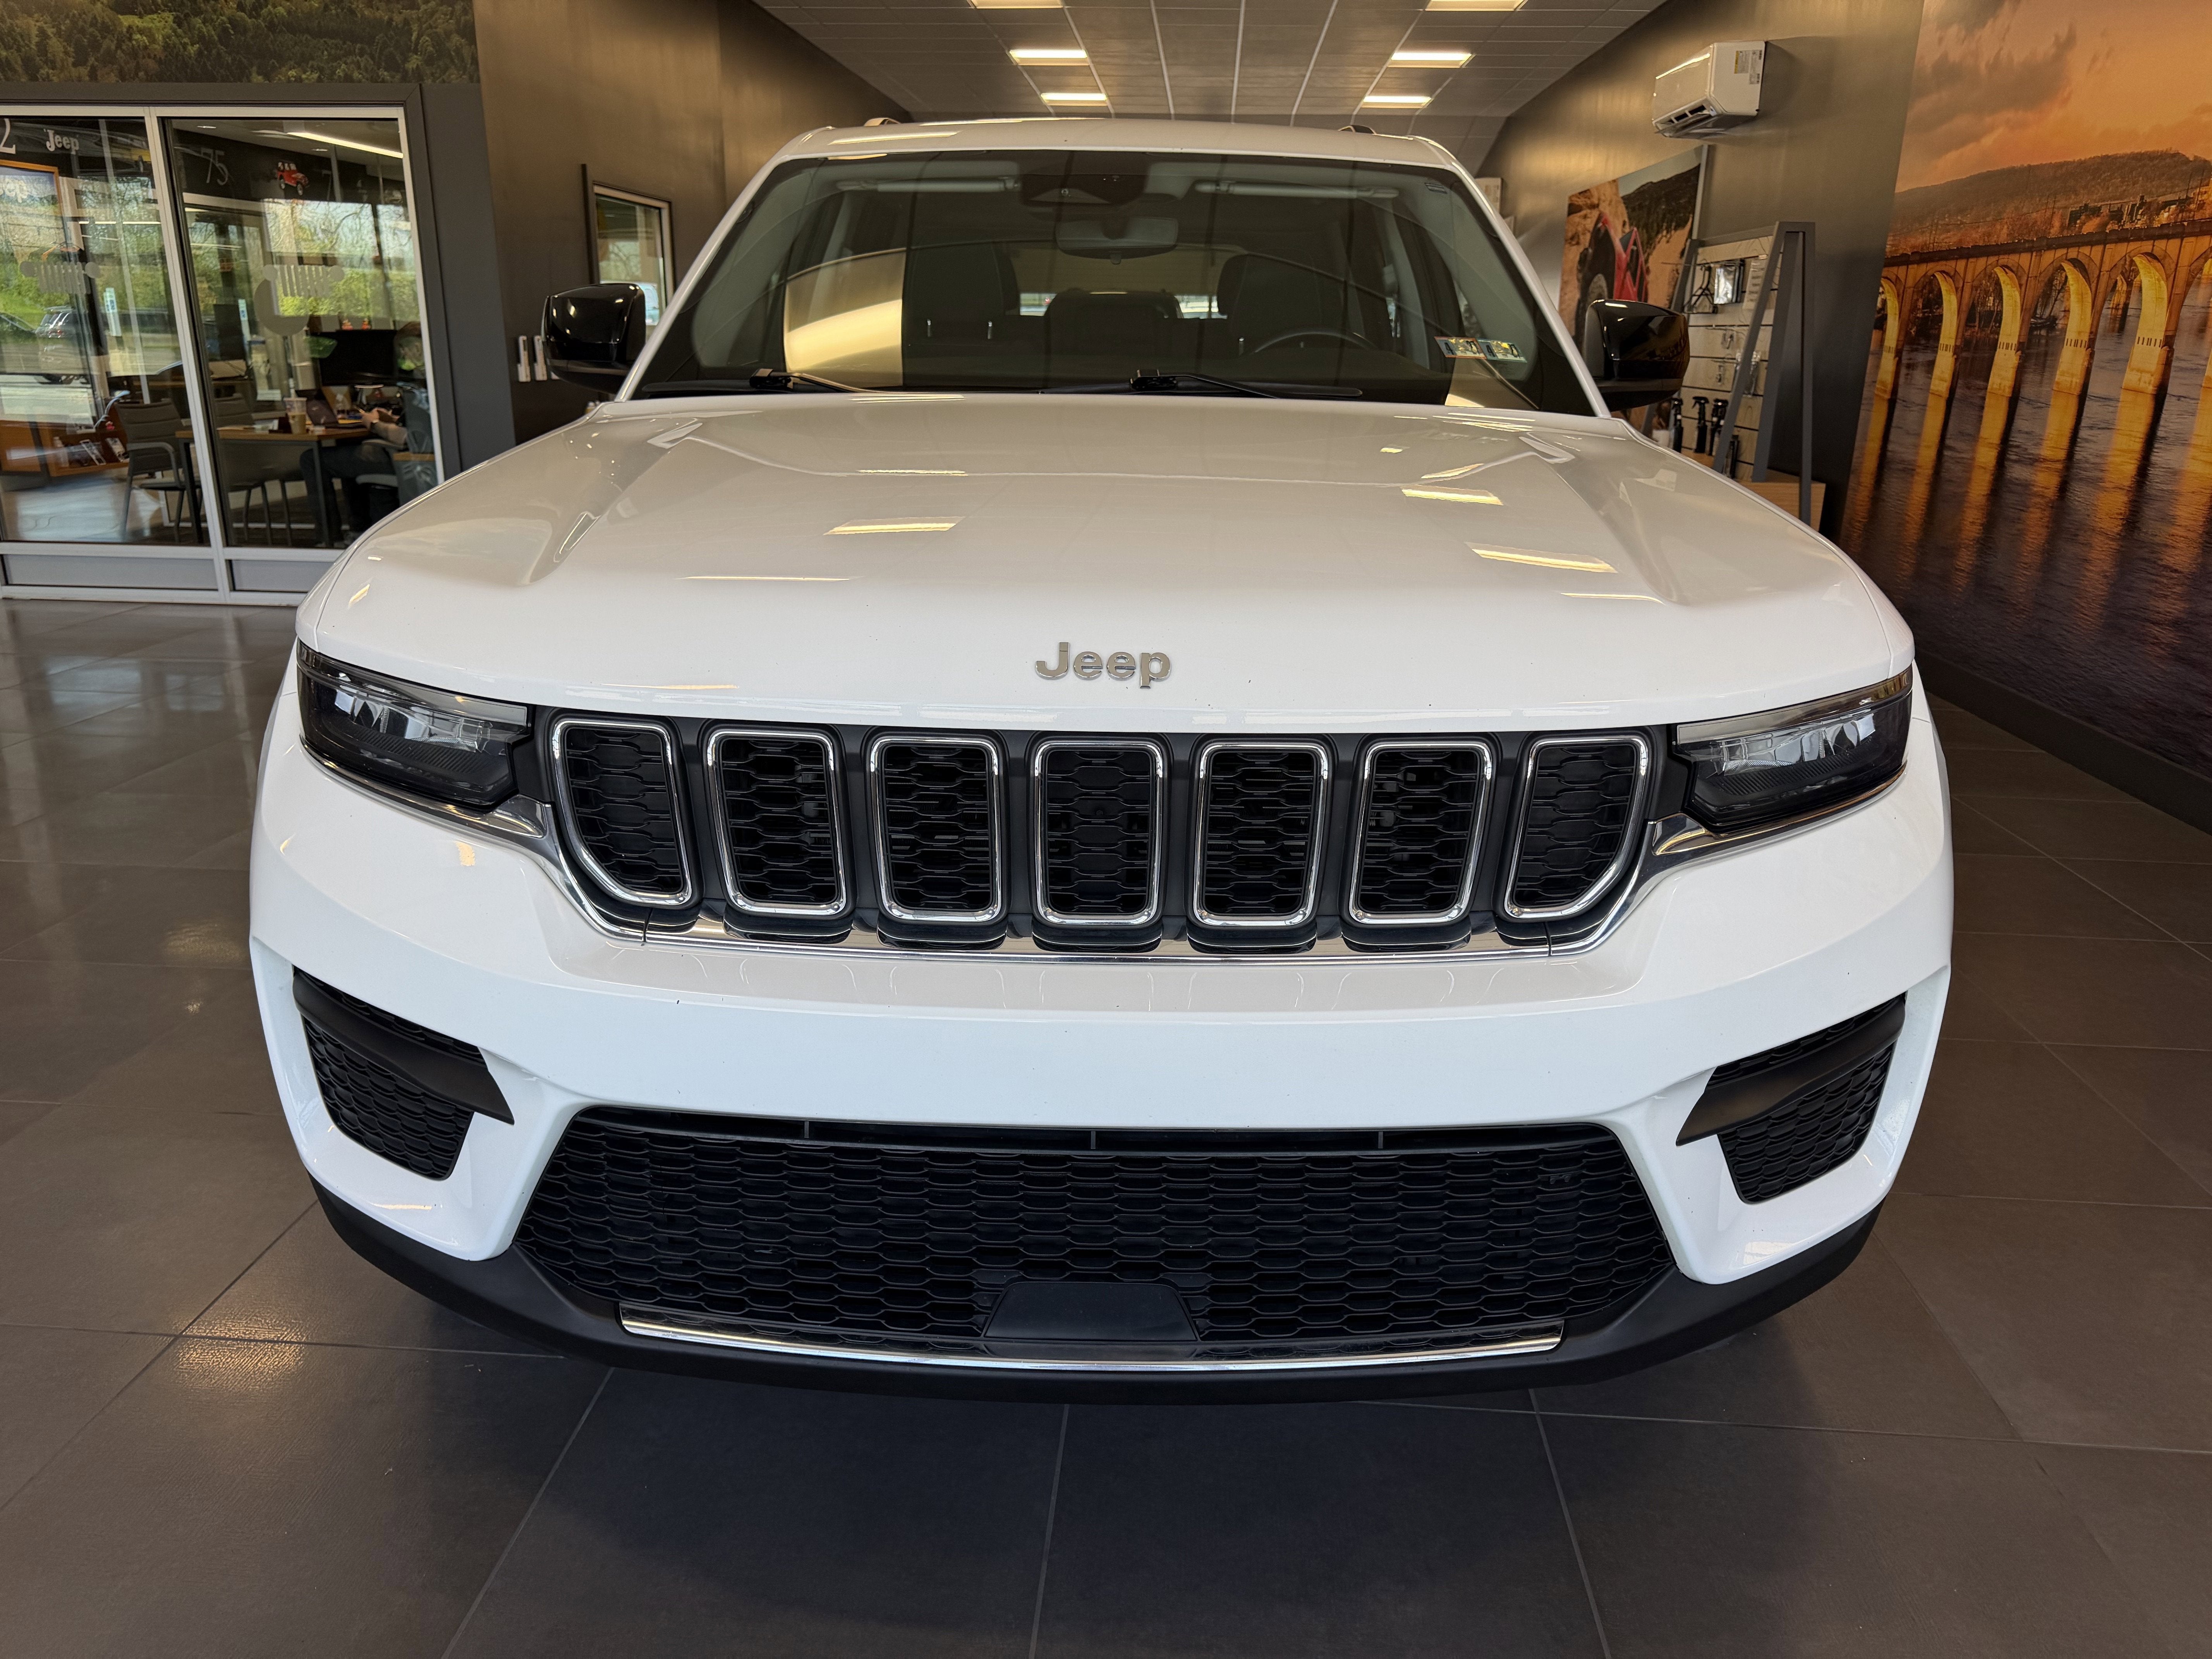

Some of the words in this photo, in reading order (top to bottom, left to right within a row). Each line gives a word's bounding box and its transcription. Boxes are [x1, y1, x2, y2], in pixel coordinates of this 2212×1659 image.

[1444, 342, 1454, 355] 4
[1486, 345, 1496, 357] 4
[1035, 642, 1171, 689] Jeep
